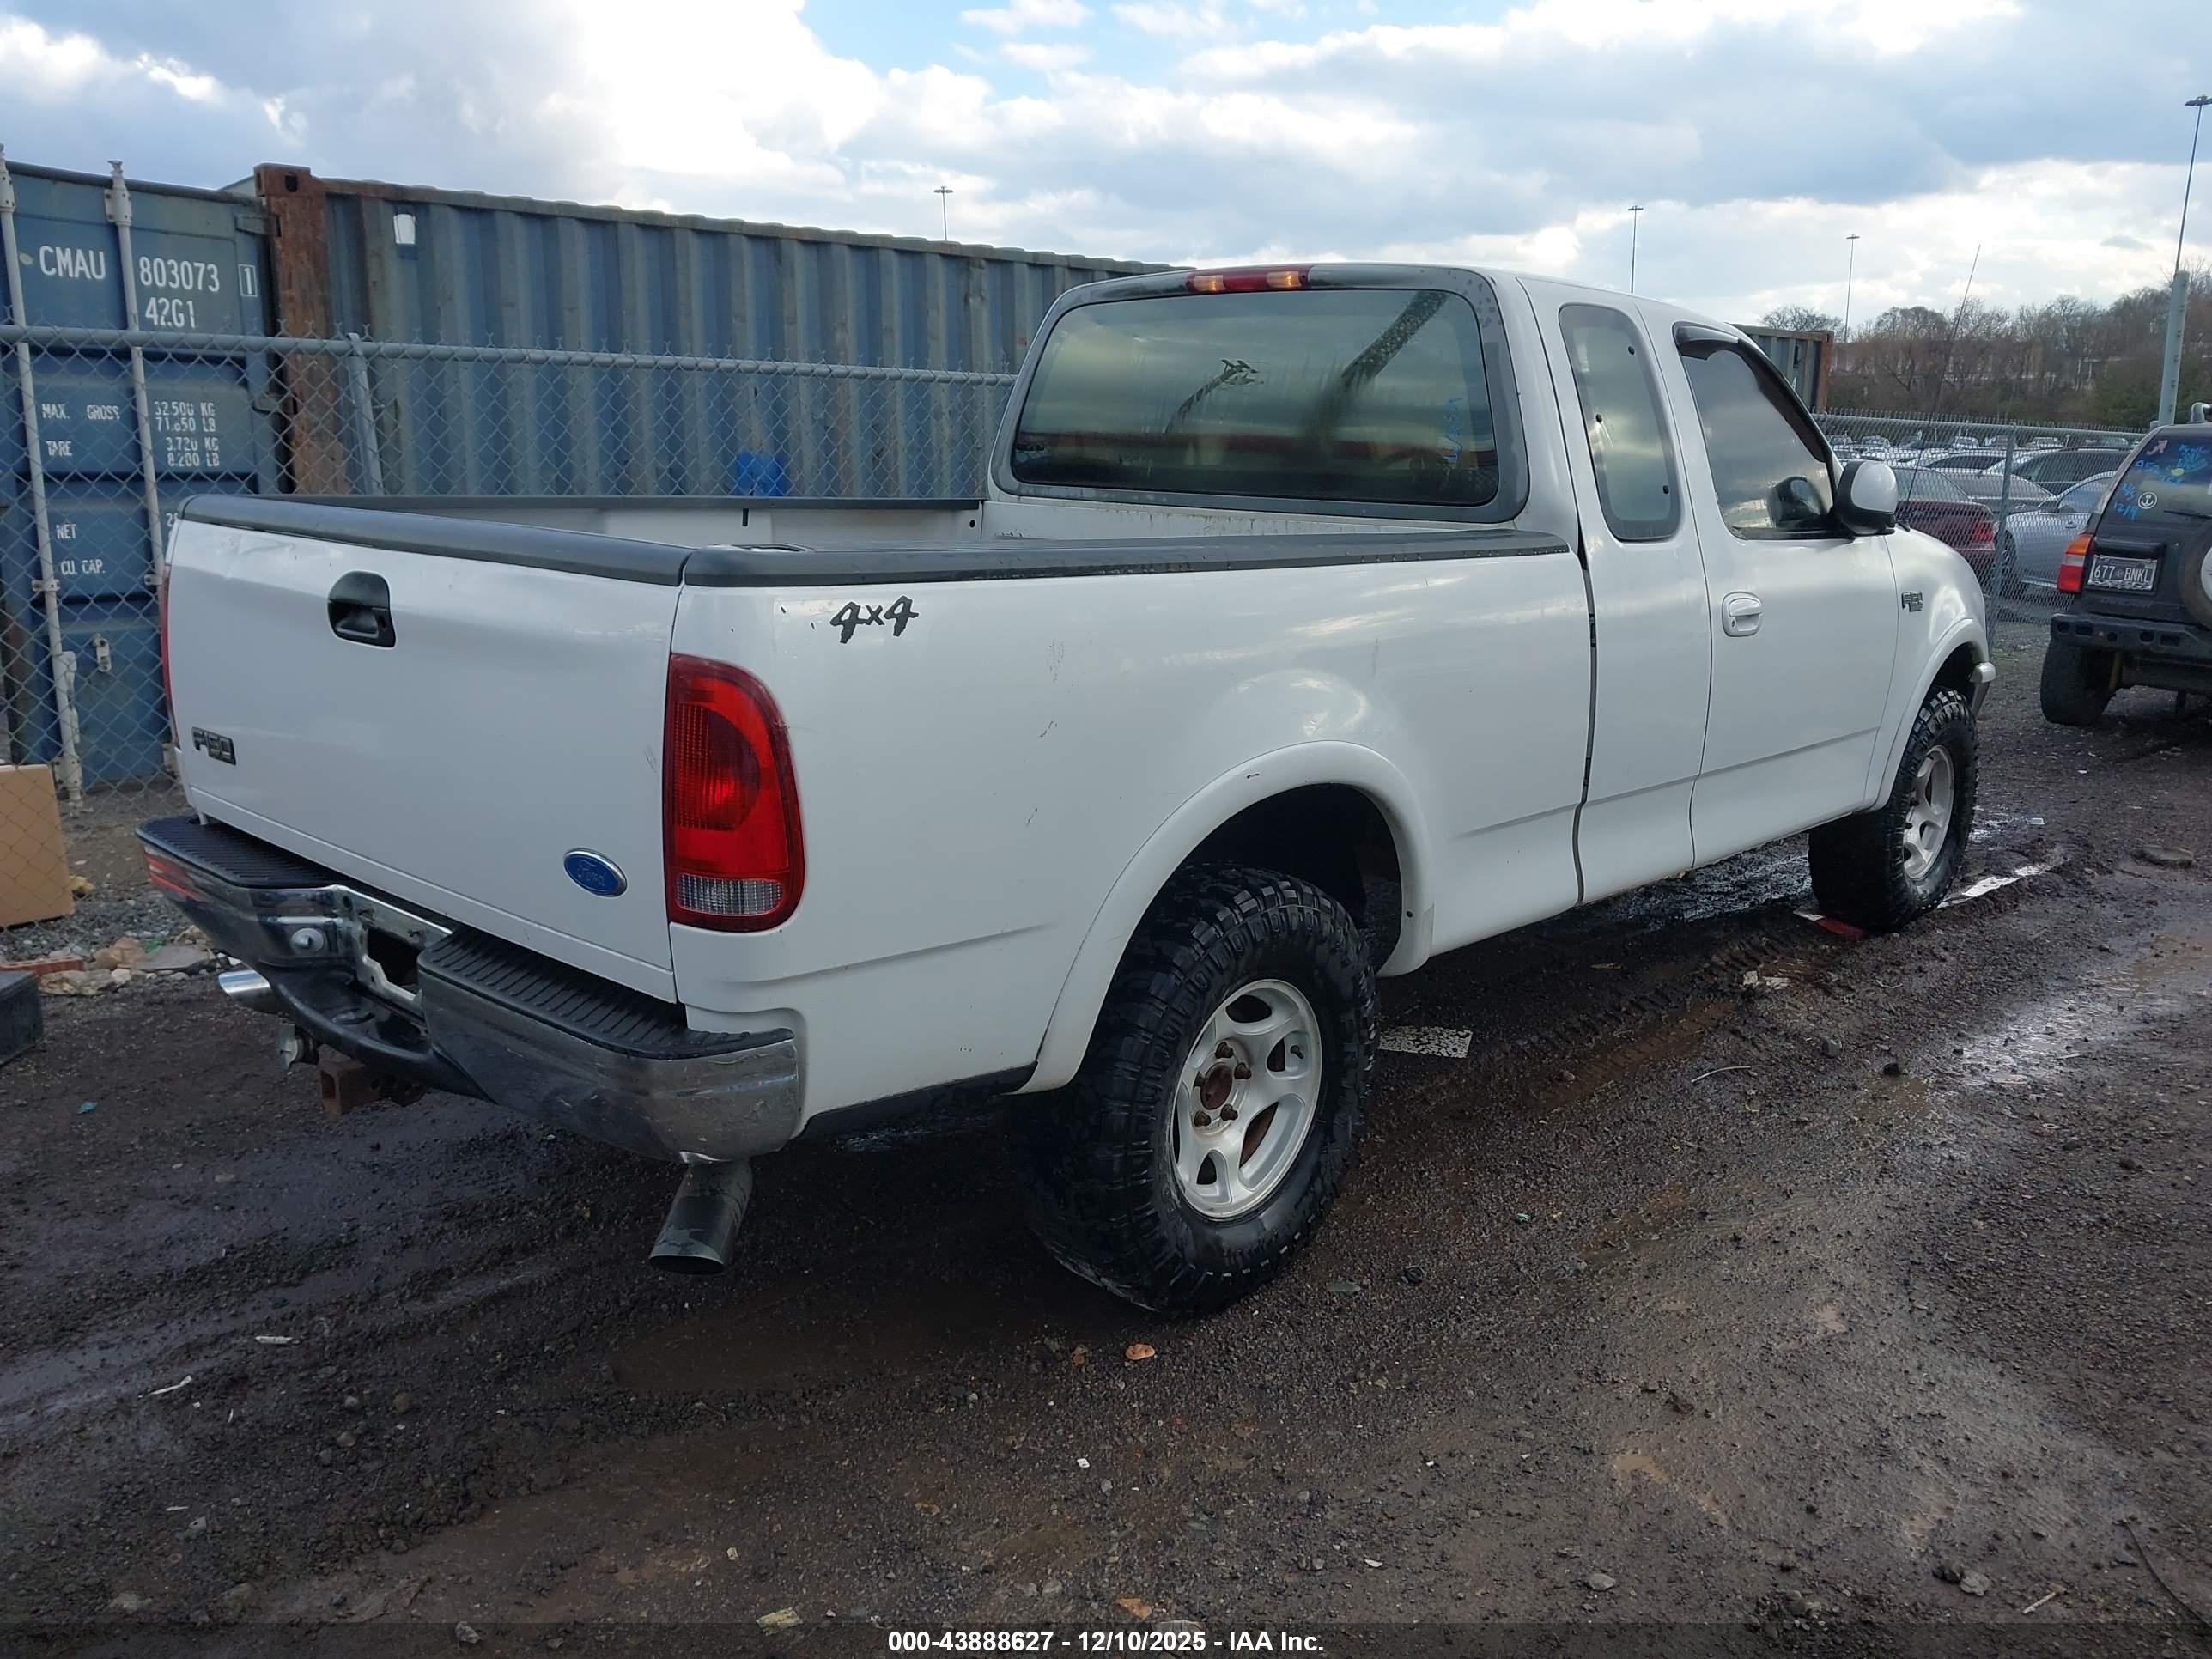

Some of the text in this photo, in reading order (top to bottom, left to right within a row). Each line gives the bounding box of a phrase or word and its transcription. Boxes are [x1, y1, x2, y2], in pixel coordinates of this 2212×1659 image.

[40, 246, 252, 295] CMAU 803073 1
[46, 441, 72, 456] TARE
[56, 523, 76, 539] NET
[61, 559, 106, 575] CU. CAP.
[2095, 565, 2115, 579] 677
